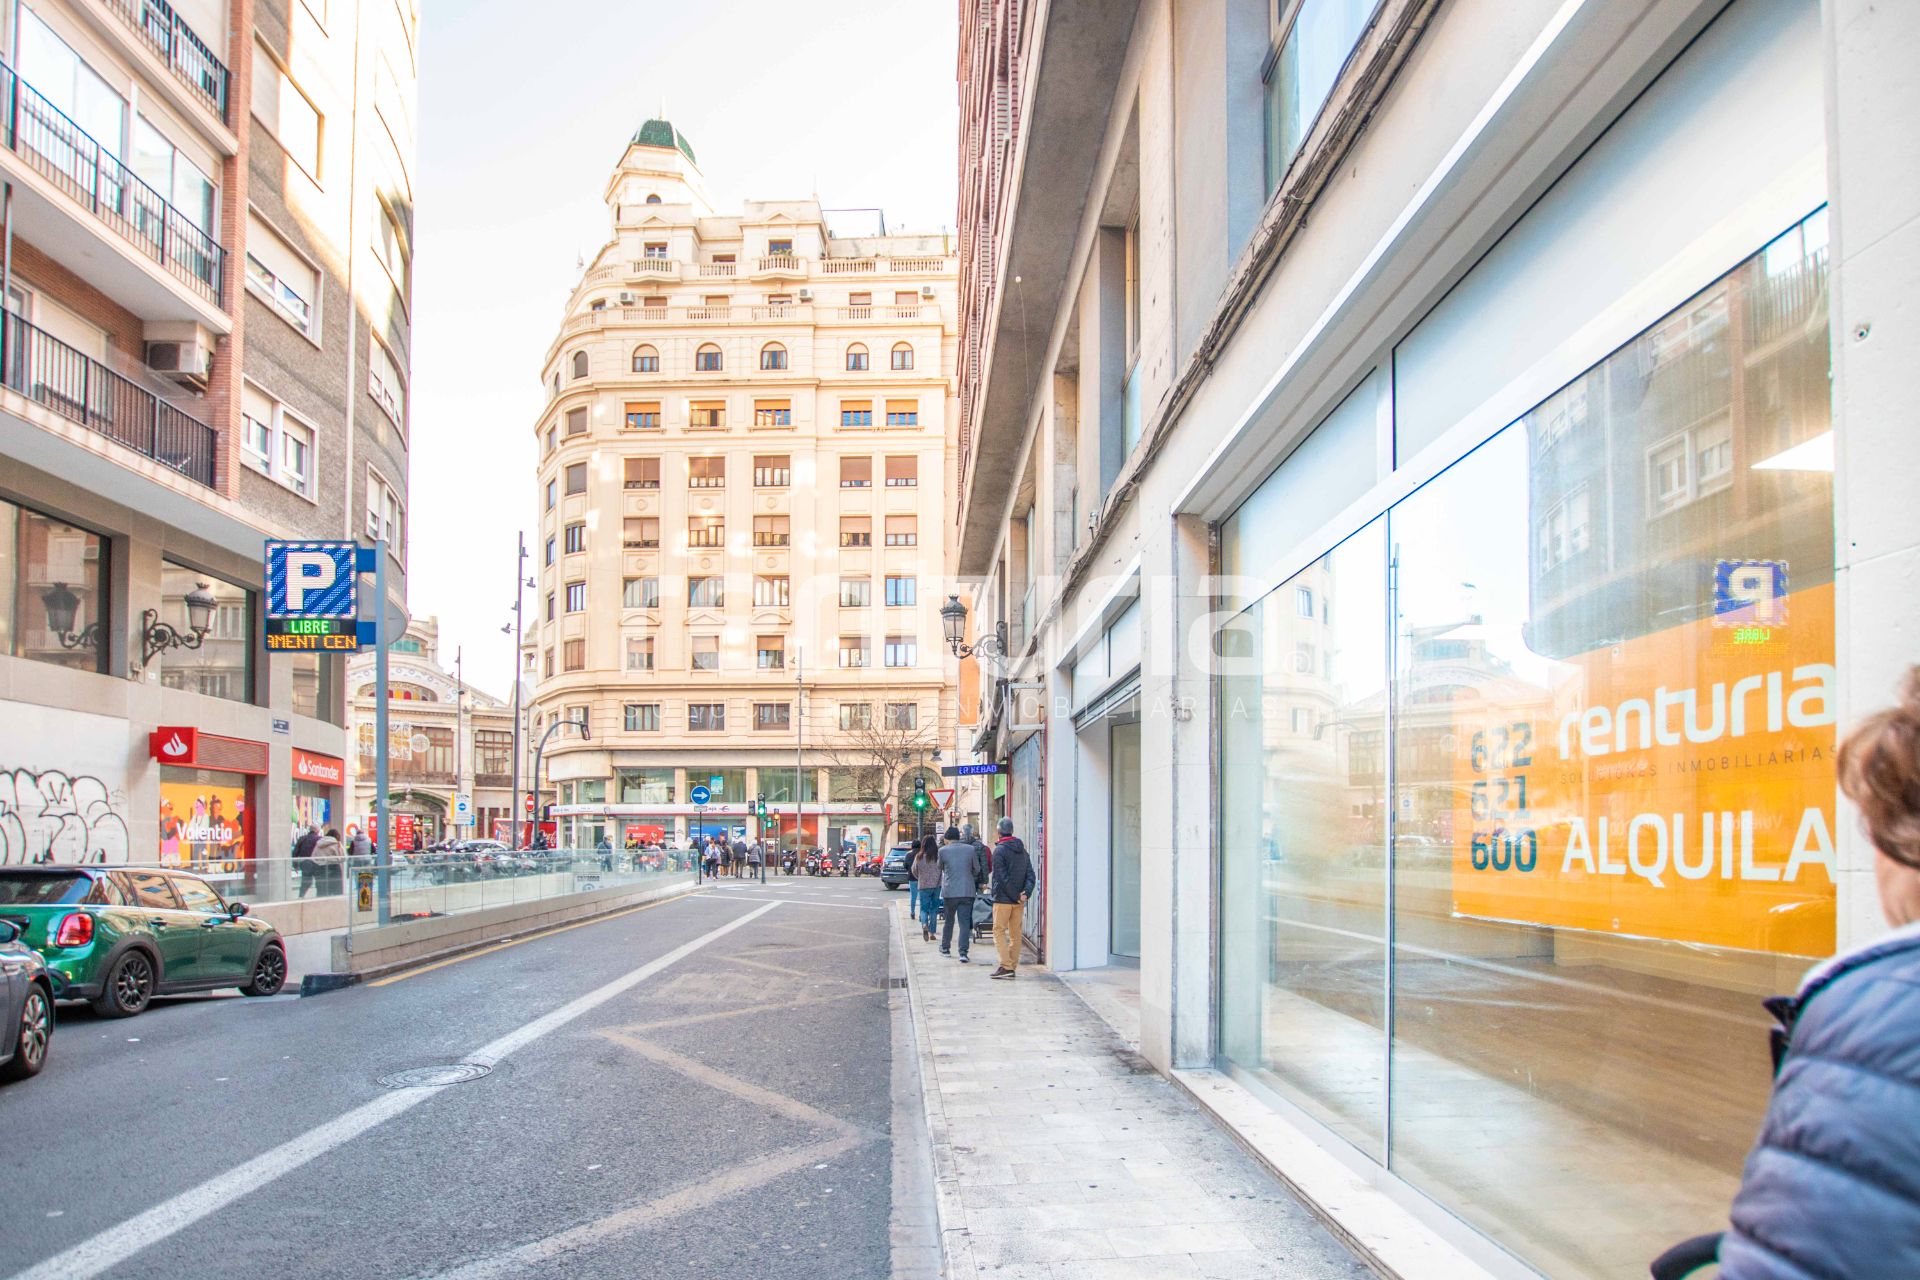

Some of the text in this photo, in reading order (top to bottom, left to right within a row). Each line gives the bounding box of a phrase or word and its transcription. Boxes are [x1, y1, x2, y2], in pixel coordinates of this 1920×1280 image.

[286, 552, 336, 610] P
[291, 621, 329, 633] LIBRE
[323, 635, 356, 649] CEN
[1559, 663, 1836, 760] renturia
[307, 760, 339, 781] Santander
[1471, 722, 1532, 773] 622
[1471, 775, 1531, 823] 621
[176, 822, 233, 841] Valentia
[1471, 826, 1537, 872] 600
[1561, 807, 1836, 888] ALQUILA
